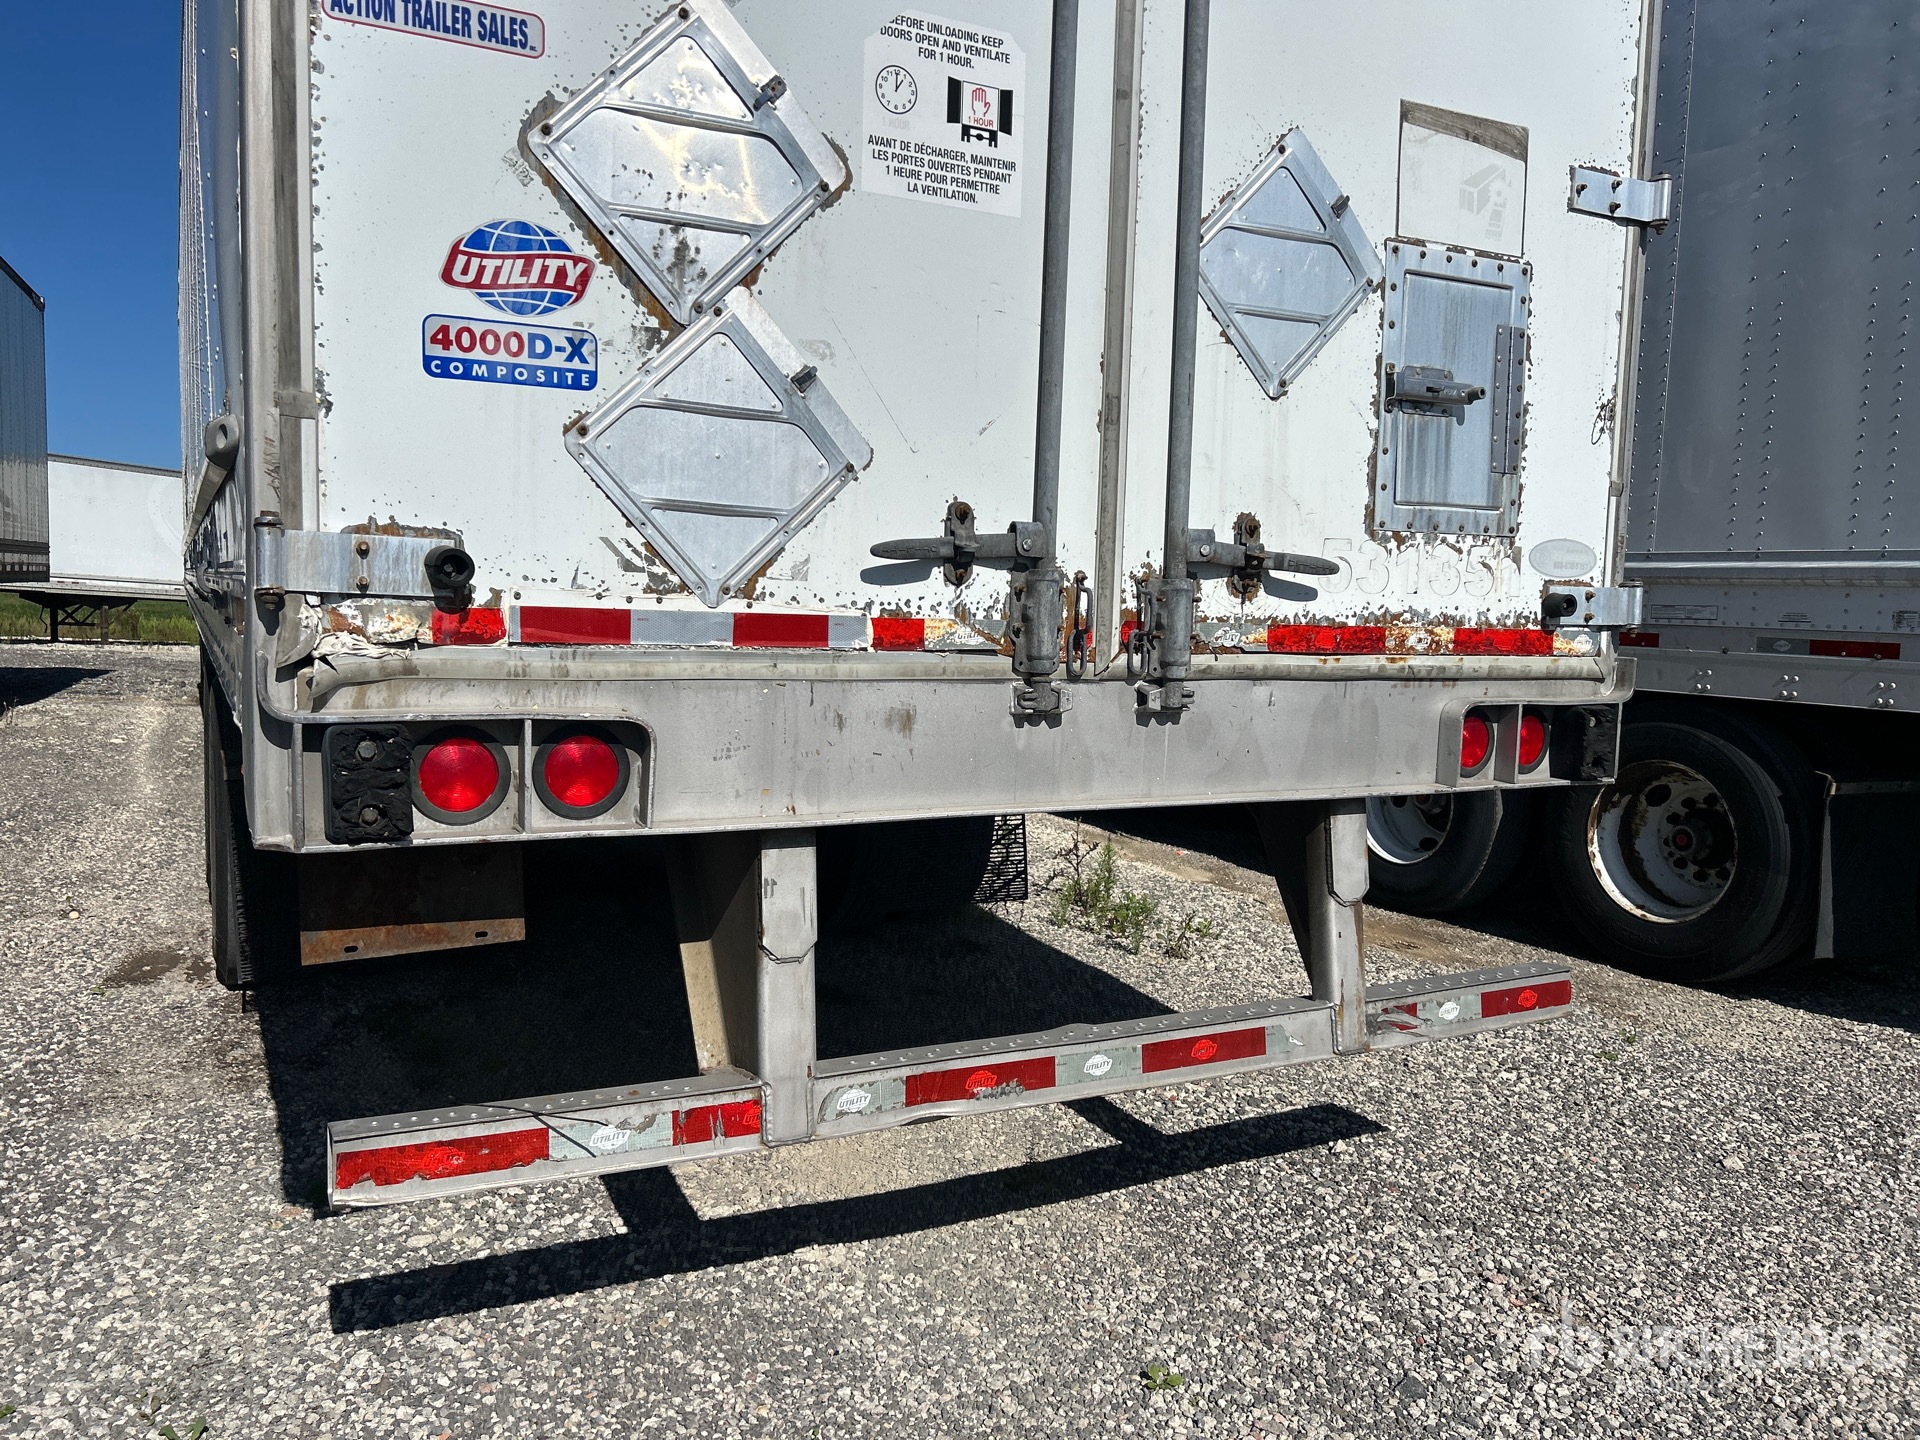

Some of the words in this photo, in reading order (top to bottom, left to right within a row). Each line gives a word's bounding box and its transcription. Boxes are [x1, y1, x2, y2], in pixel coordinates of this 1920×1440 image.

[402, 0, 472, 38] TRAILER
[478, 10, 528, 50] SALES
[889, 14, 925, 31] EFORE
[927, 21, 979, 44] UNLOADING
[982, 35, 1004, 49] KEEP
[880, 25, 913, 42] DOORS
[915, 32, 939, 47] OPEN
[942, 39, 961, 53] AND
[964, 45, 1011, 64] VENTILATE
[918, 46, 936, 61] FOR
[939, 52, 944, 62] 1
[947, 54, 975, 69] HOUR.
[881, 75, 889, 83] 10
[889, 117, 910, 130] HOUR
[973, 116, 994, 128] HOUR
[868, 134, 898, 149] AVANT
[900, 140, 912, 151] DE
[914, 139, 969, 164] DÉCHARGER,
[970, 153, 1016, 172] MAINTENIR
[872, 148, 889, 161] LES
[891, 151, 925, 168] PORTES
[927, 158, 971, 177] OUVERTES
[974, 167, 1012, 184] PENDANT
[886, 165, 890, 175] 1
[893, 166, 922, 181] HEURE
[924, 171, 948, 186] POUR
[950, 176, 1000, 195] PERMETTRE
[907, 181, 919, 194] LA
[921, 184, 978, 204] VENTILATION.
[451, 253, 588, 287] UTILITY
[430, 324, 590, 365] 4000D-X
[430, 360, 590, 387] COMPOSITE
[1086, 1060, 1111, 1072] UTILITY
[839, 1095, 868, 1108] UTILITY
[592, 1131, 628, 1144] UTILITY
